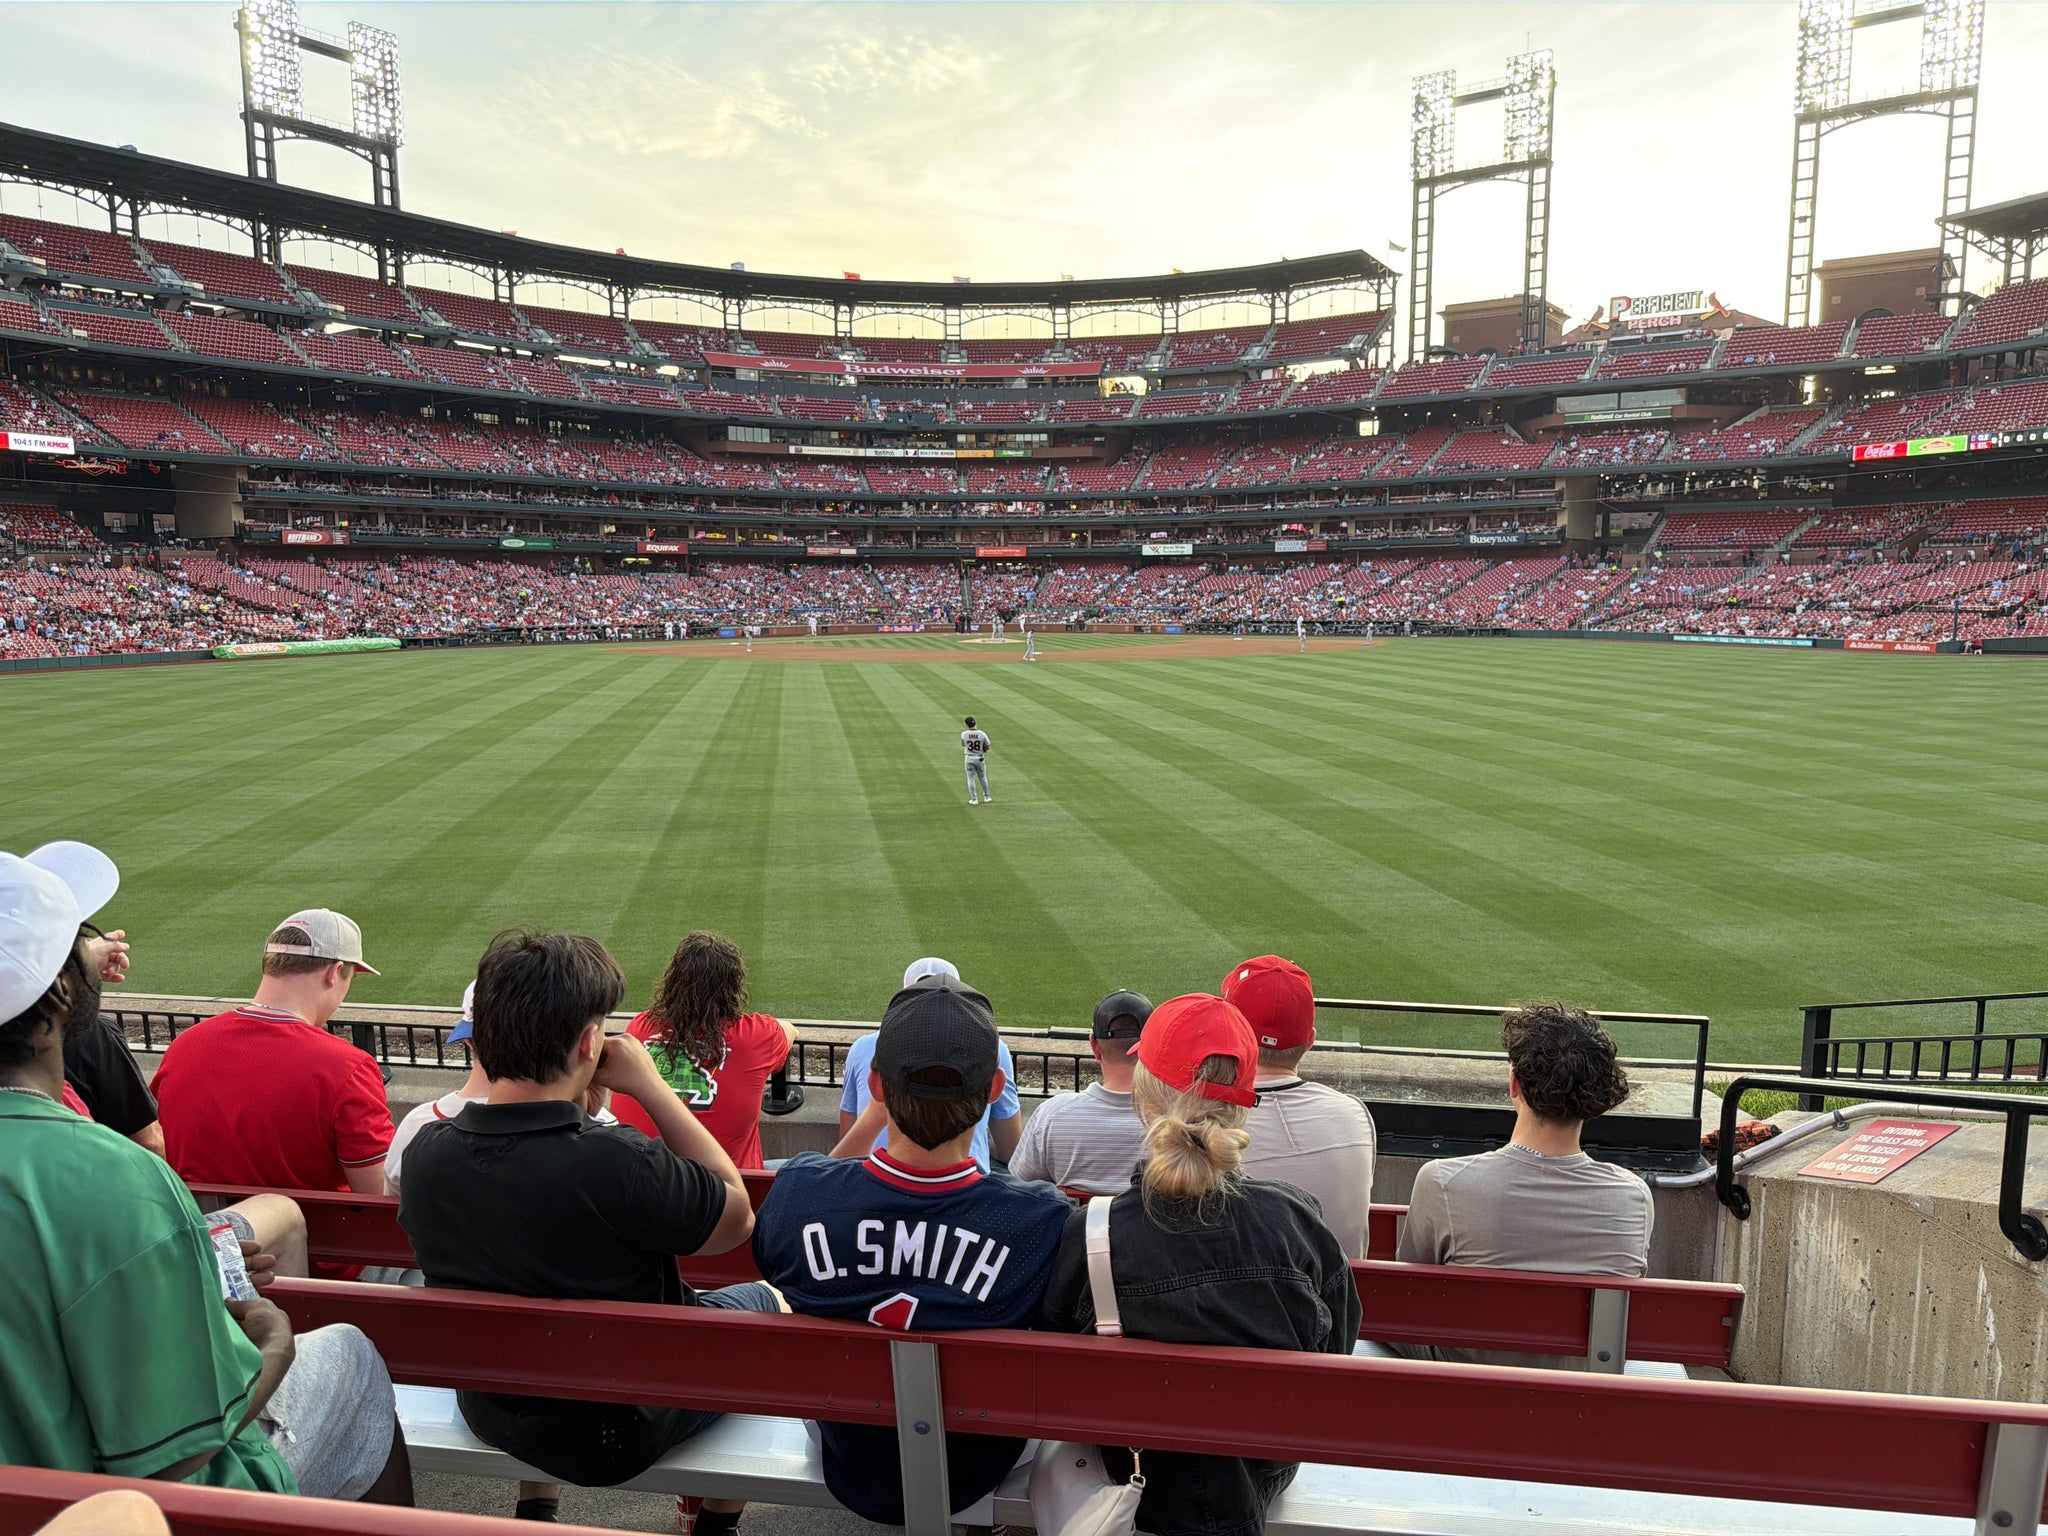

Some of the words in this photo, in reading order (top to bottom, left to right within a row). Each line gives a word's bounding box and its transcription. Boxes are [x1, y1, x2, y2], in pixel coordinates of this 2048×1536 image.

[1610, 290, 1703, 320] PERFICIENT
[1628, 316, 1682, 330] PERCH
[843, 364, 966, 375] Budweiser
[13, 438, 32, 446] 104.1
[47, 441, 70, 449] KMOX
[1864, 443, 1897, 458] Coca-Cola
[646, 544, 680, 553] EQUIFAX
[967, 741, 980, 752] 38
[1881, 1127, 1927, 1136] ENTERING
[1856, 1134, 1875, 1142] THE
[1872, 1136, 1903, 1145] GRASS
[1901, 1138, 1928, 1147] AREA
[1850, 1144, 1873, 1152] WILL
[1871, 1146, 1906, 1155] RESULT
[1848, 1164, 1887, 1175] ARREST
[803, 1222, 848, 1281] O.
[858, 1219, 1010, 1302] SMITH
